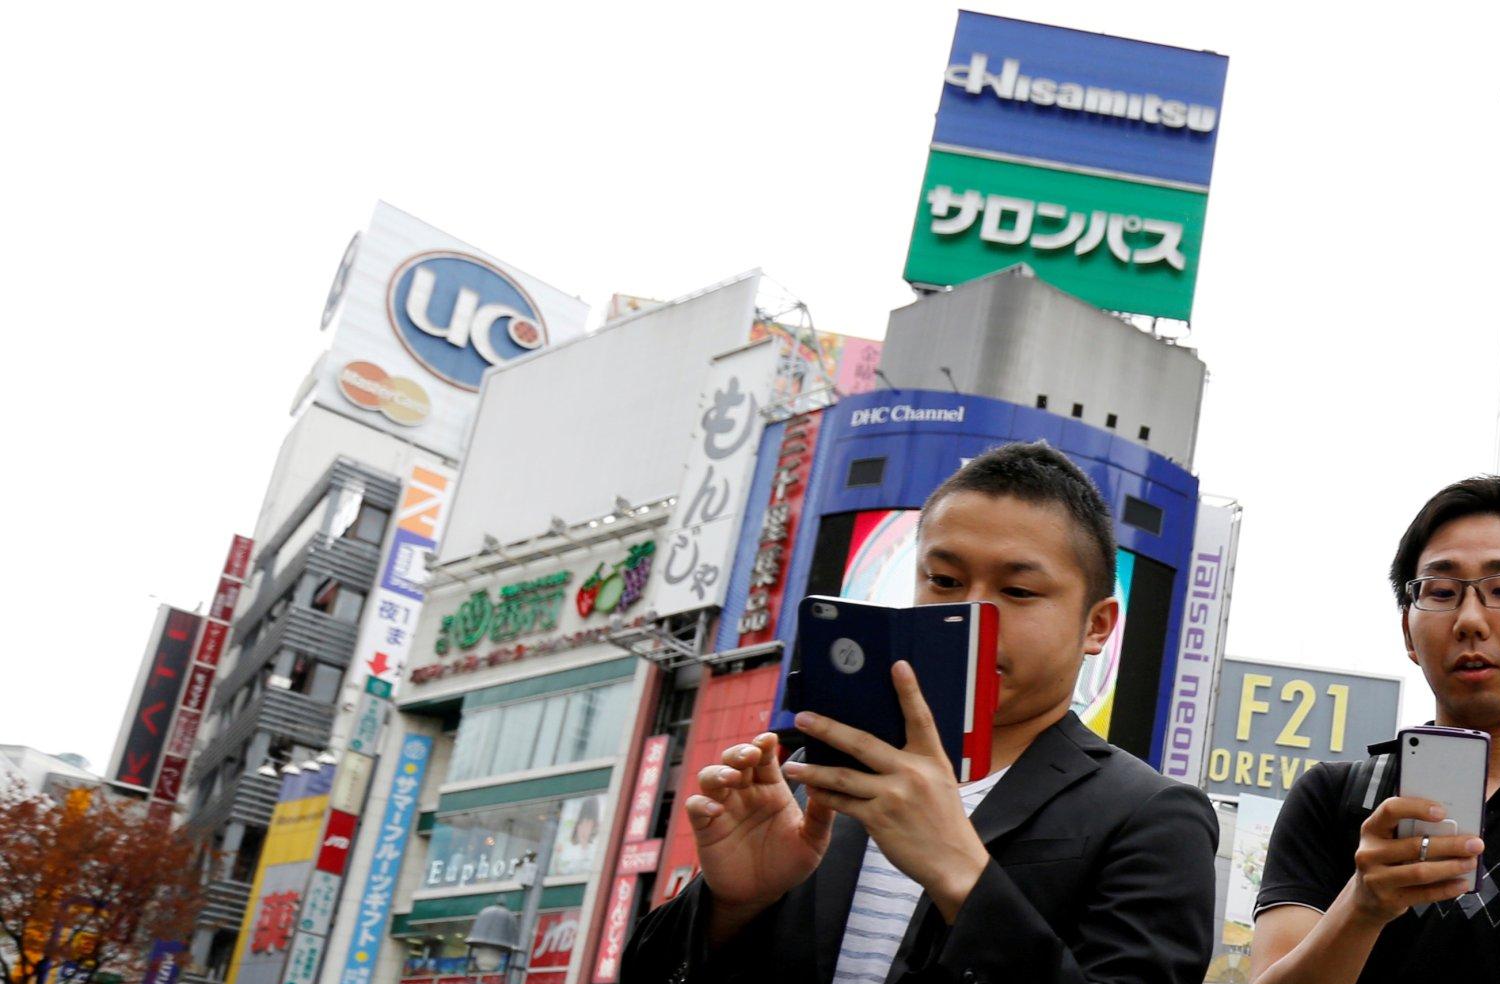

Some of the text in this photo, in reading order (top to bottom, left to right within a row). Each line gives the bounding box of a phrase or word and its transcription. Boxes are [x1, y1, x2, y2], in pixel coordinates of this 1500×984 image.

[945, 53, 1217, 132] Hisamitsu
[928, 185, 1187, 271] サロンパス
[851, 405, 964, 427] DHC Channel
[663, 376, 757, 598] もんじゃ
[1167, 546, 1223, 776] Taisei neon
[1236, 673, 1349, 752] F21
[1209, 748, 1320, 790] OREV
